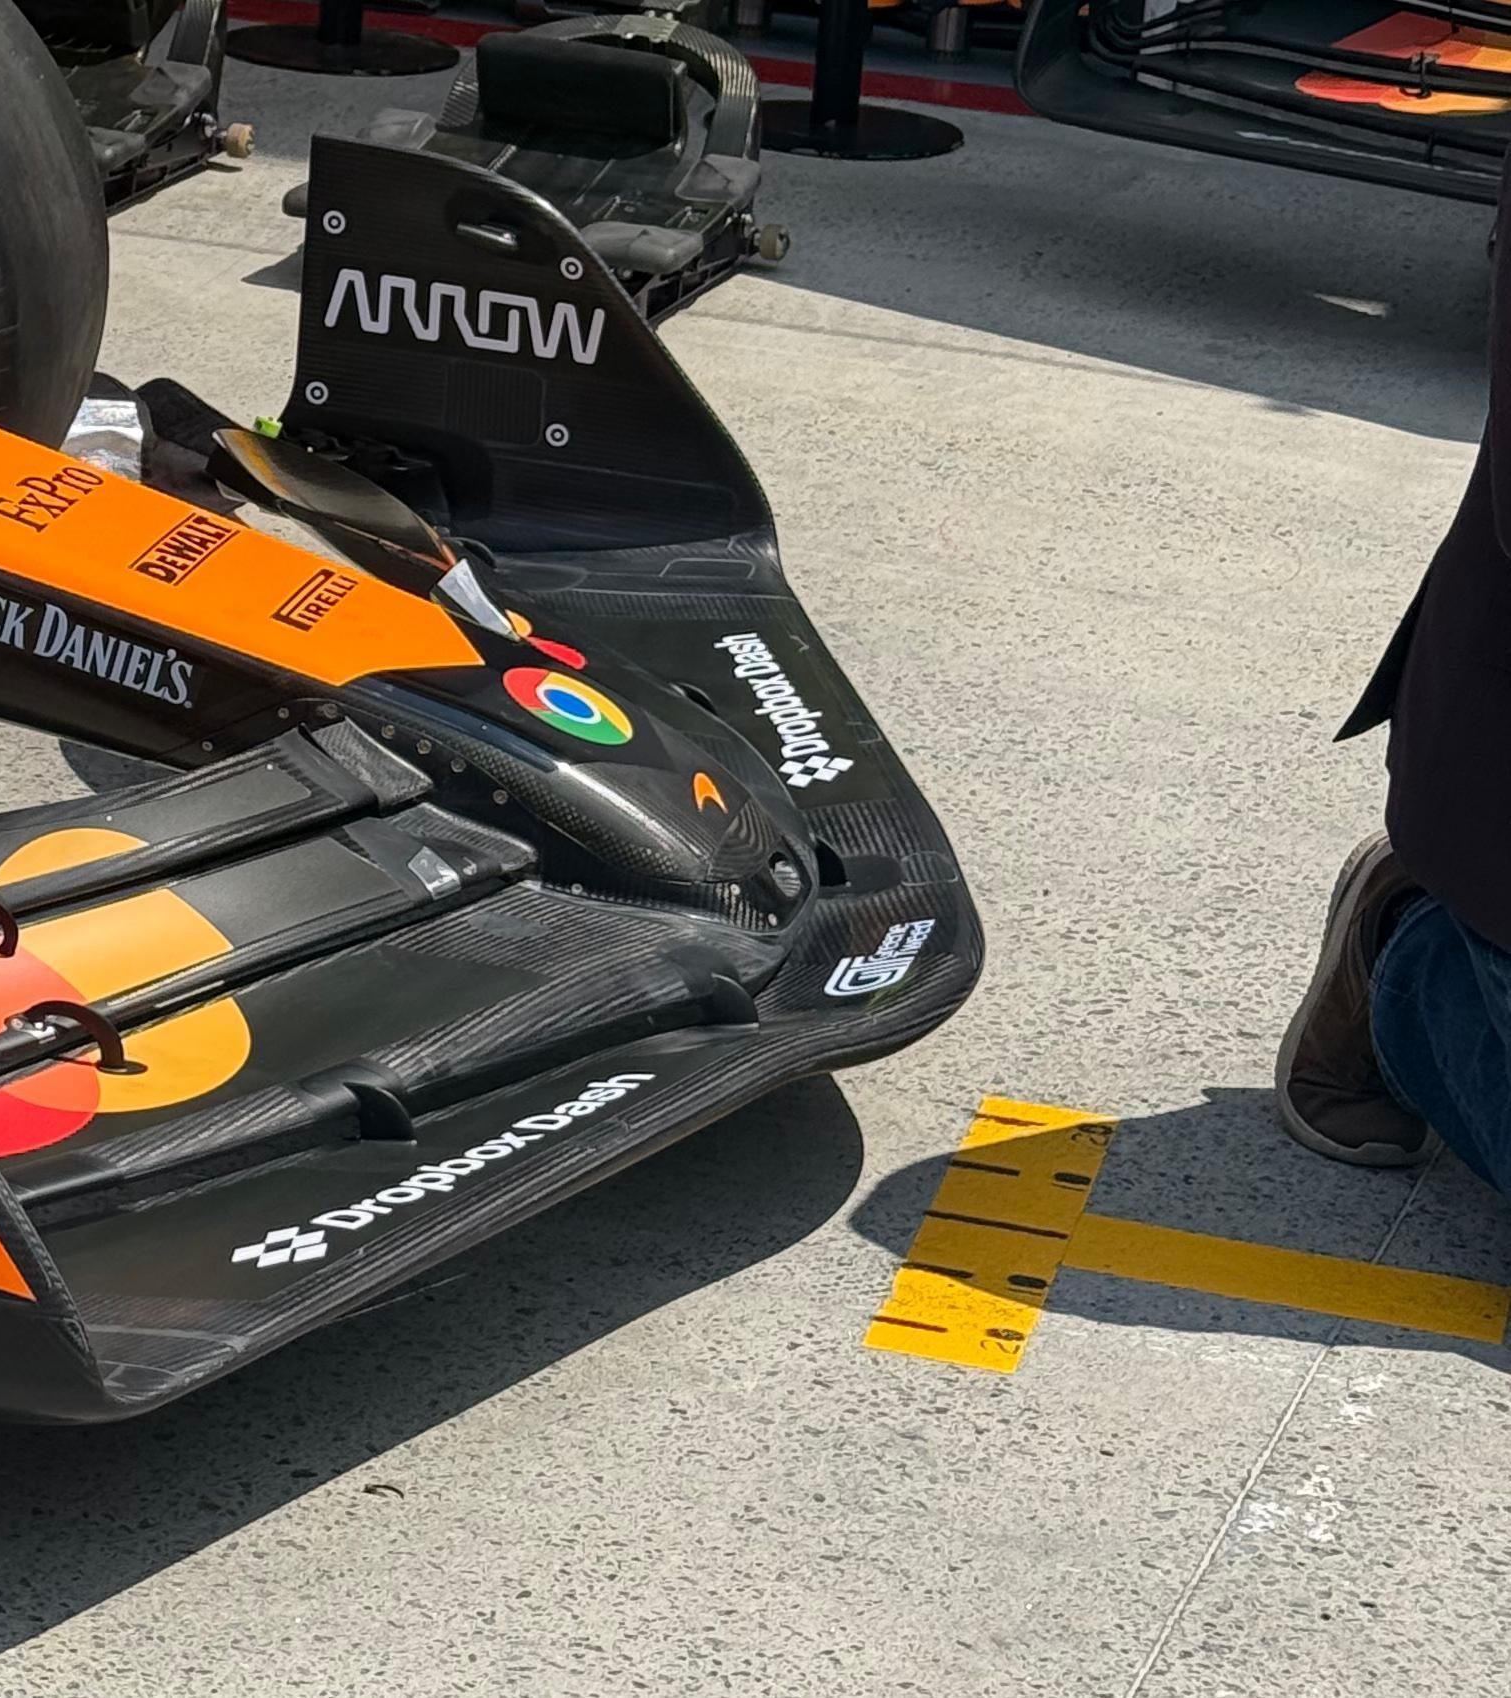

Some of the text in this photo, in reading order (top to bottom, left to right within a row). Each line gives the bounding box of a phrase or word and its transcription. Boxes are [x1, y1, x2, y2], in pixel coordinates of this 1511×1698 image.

[323, 267, 605, 365] ARROW
[270, 568, 359, 632] PIRELLI
[713, 632, 830, 759] Dropbox Dash
[309, 1073, 657, 1231] Dropbox Dash
